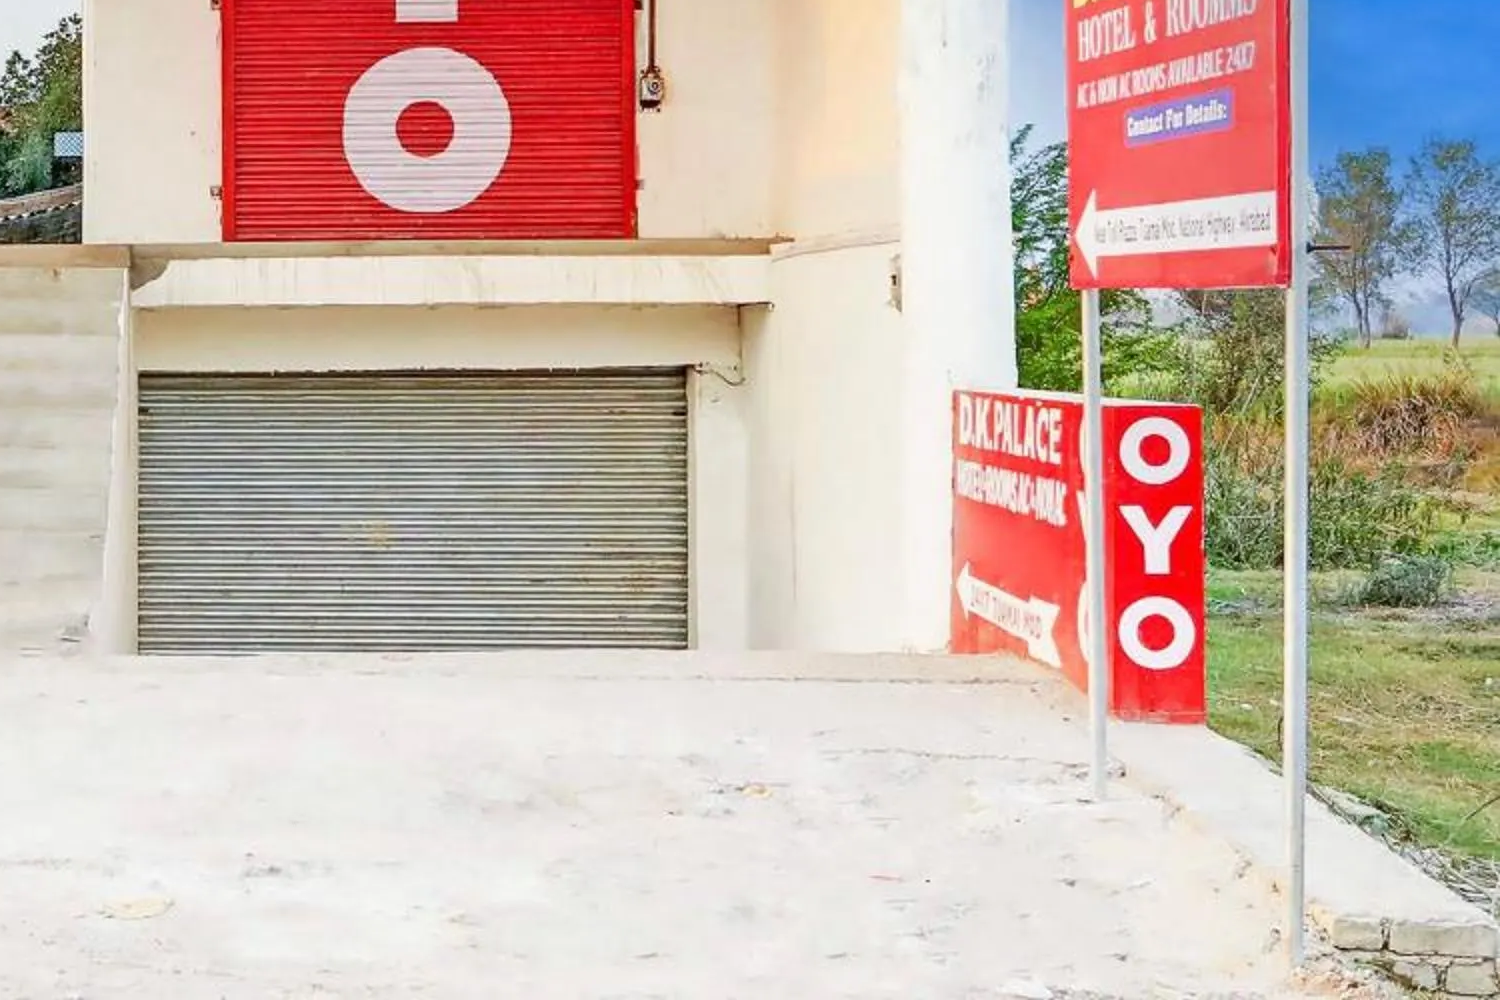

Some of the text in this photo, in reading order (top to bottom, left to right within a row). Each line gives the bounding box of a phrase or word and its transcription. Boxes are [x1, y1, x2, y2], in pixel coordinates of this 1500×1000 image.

[1077, 5, 1136, 62] HOTEL
[1144, 0, 1157, 44] &
[1167, 48, 1224, 88] AVAILABLE
[1127, 110, 1164, 137] Contact
[1165, 108, 1183, 130] For
[1118, 417, 1196, 670] OYO
